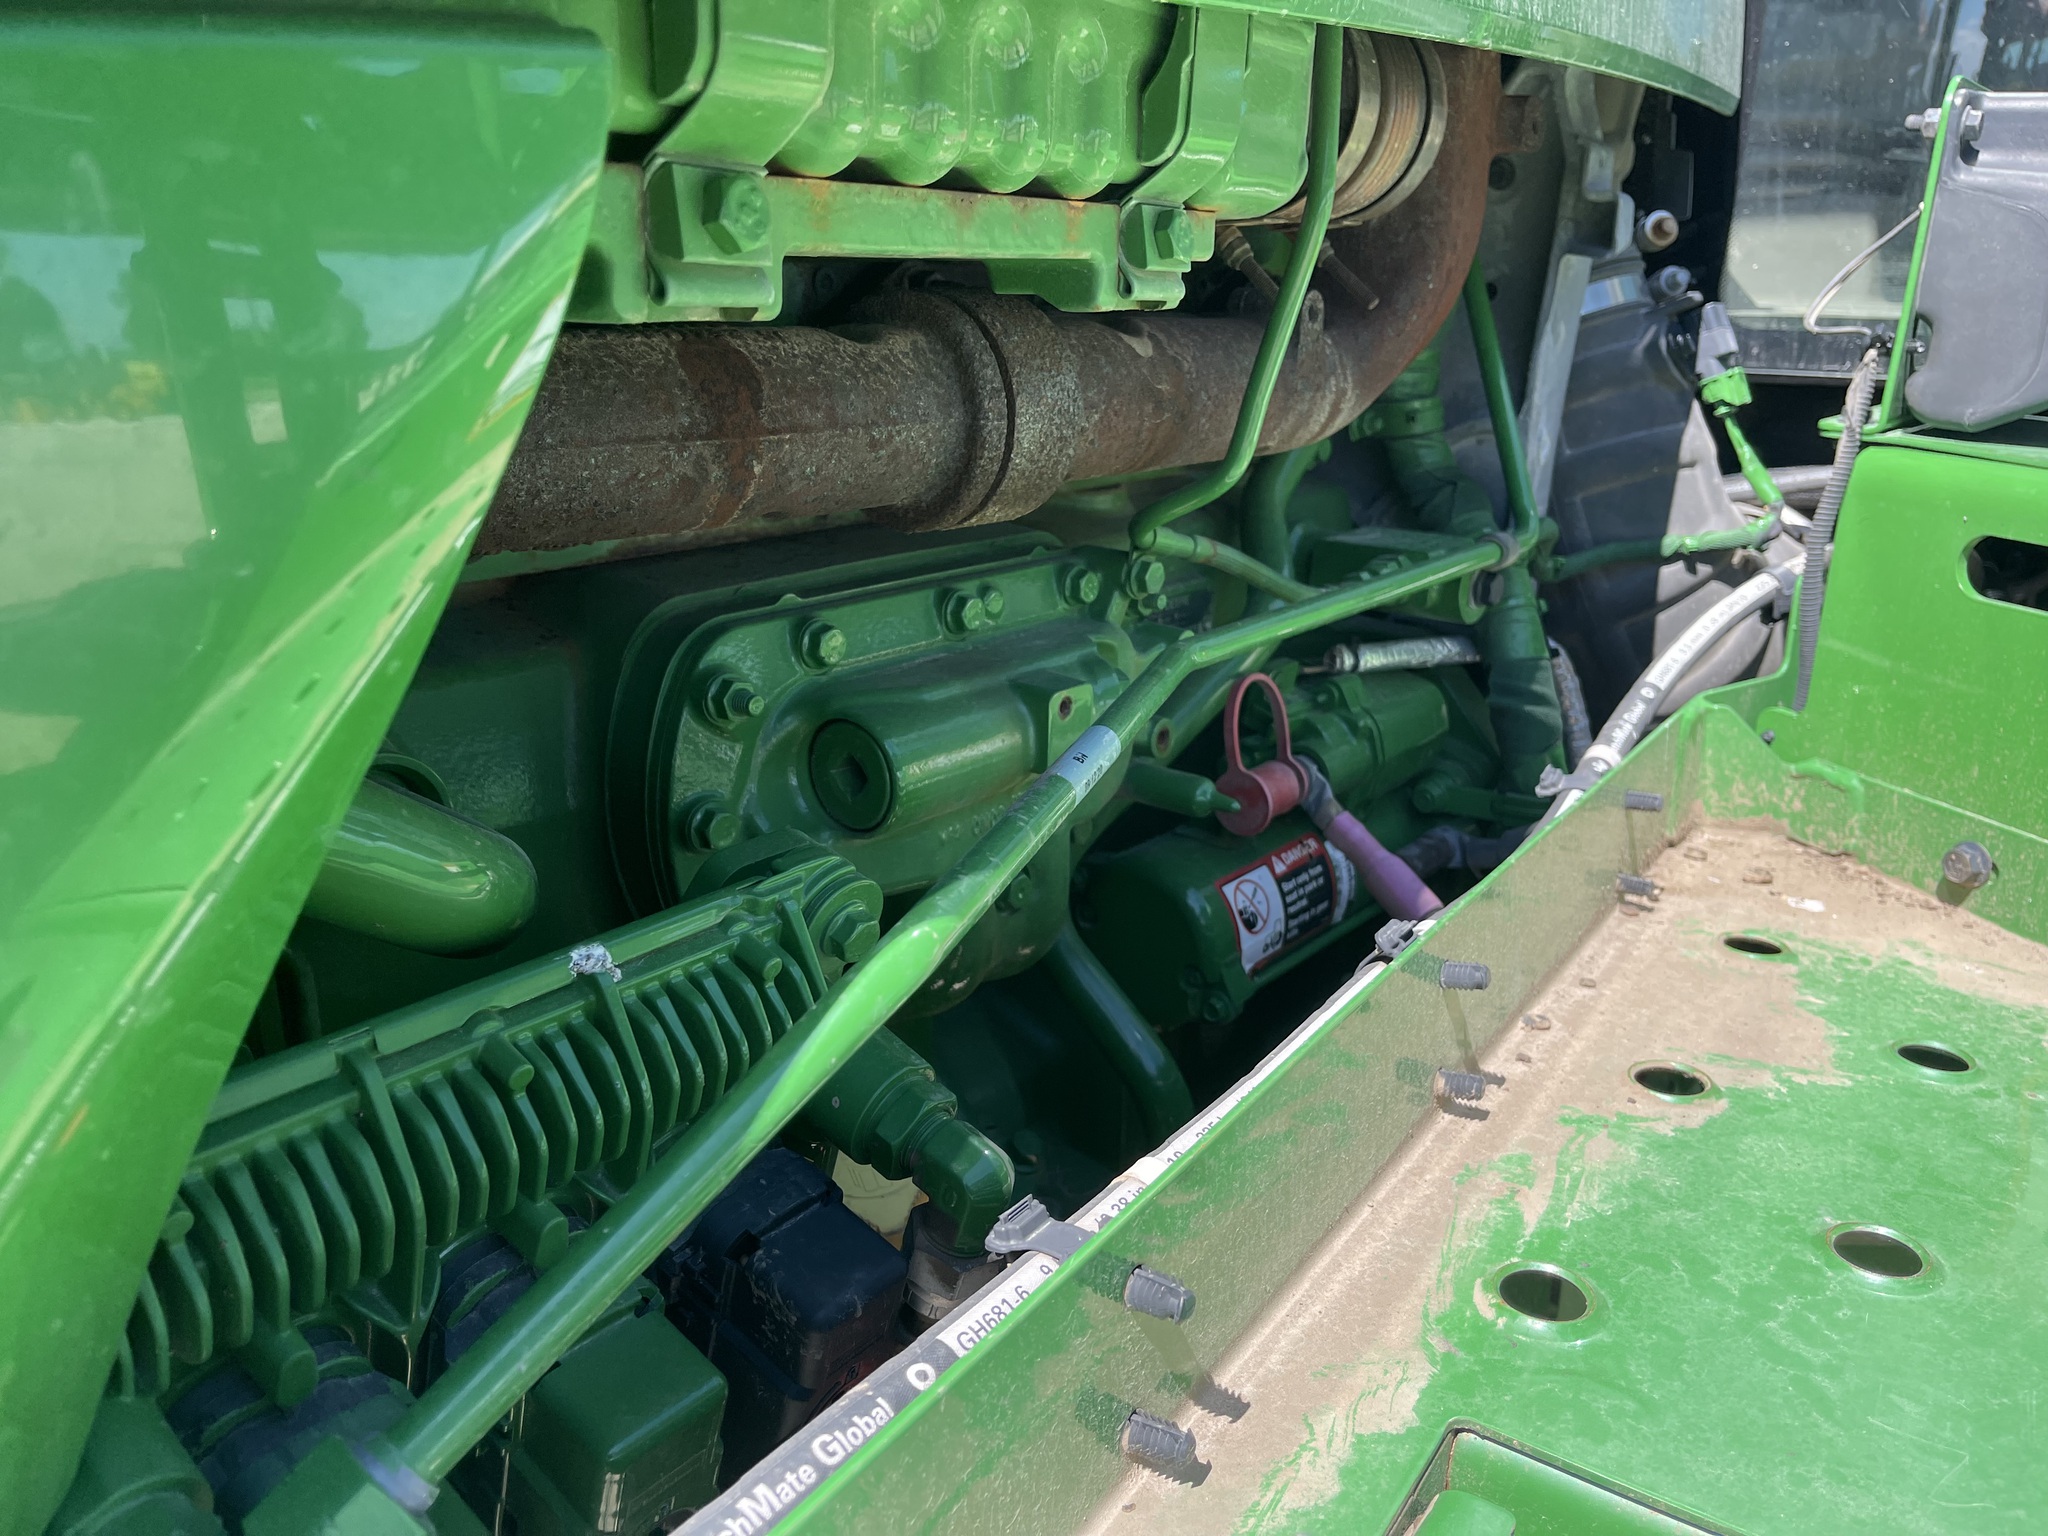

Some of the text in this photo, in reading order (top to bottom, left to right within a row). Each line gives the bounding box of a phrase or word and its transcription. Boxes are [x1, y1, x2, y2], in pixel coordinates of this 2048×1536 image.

[1281, 838, 1319, 865] DANGER
[811, 1397, 895, 1466] Global
[957, 1285, 1030, 1351] GH681-6
